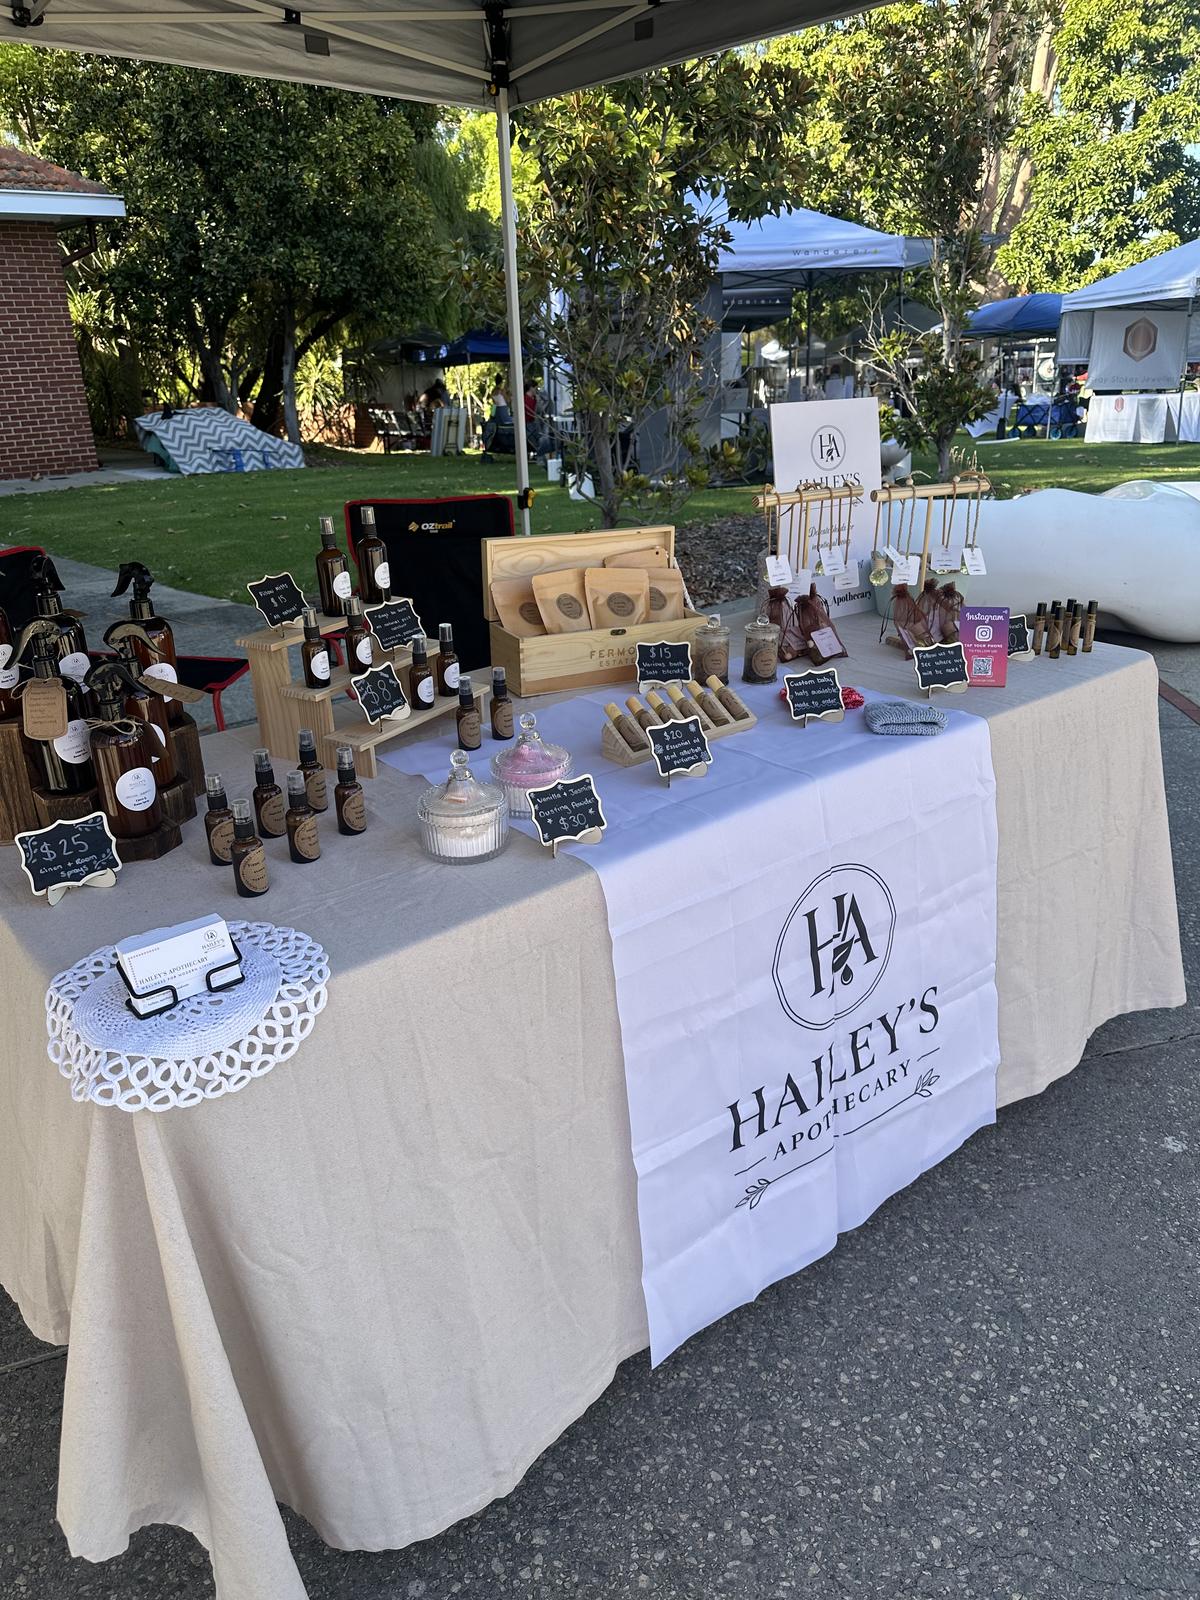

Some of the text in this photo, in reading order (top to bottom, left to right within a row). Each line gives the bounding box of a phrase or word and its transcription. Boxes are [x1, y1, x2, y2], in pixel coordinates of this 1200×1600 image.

[832, 590, 872, 606] Apothecary
[966, 612, 1005, 624] Instagram
[590, 647, 636, 659] FERMO
[649, 646, 672, 659] $15
[790, 677, 834, 687] Custom baby
[367, 680, 392, 706] $8
[664, 730, 683, 742] $20
[666, 739, 691, 751] Essential
[537, 793, 562, 804] Vanilla
[539, 797, 595, 818] Dusting Powder
[559, 813, 587, 832] $30
[40, 834, 89, 862] $25
[802, 892, 879, 998] HA
[139, 956, 209, 986] HAILEY'S APOTHECARY
[726, 986, 940, 1153] HAILEY'S
[774, 1059, 911, 1161] APOTHECARY
